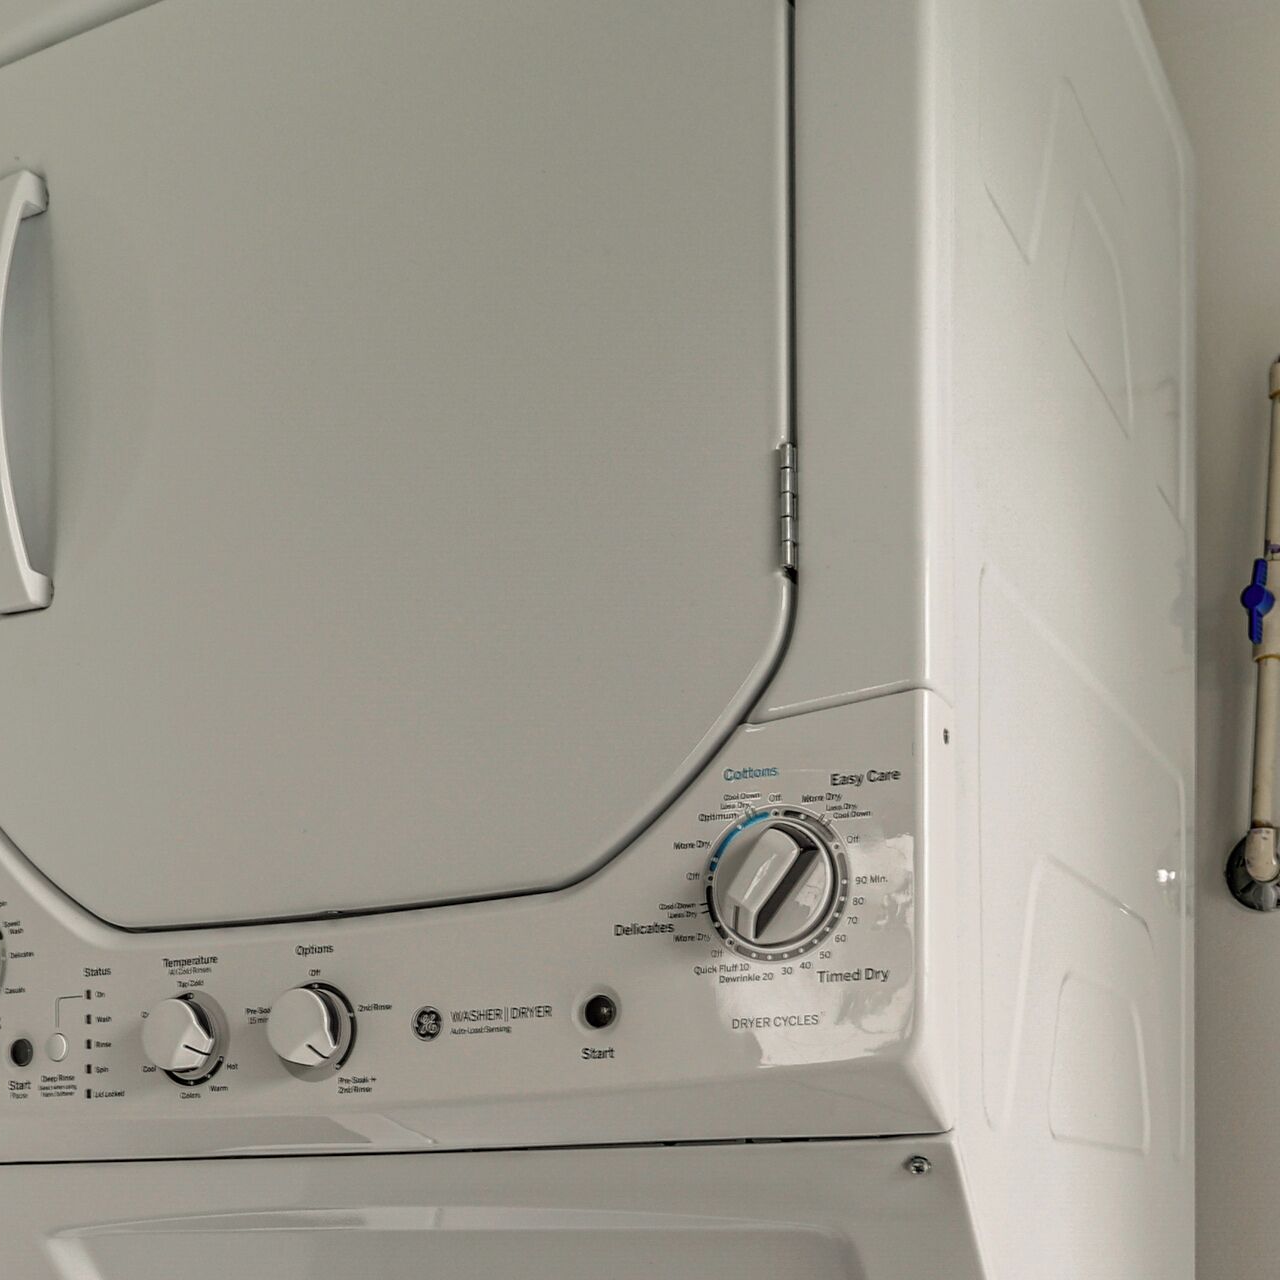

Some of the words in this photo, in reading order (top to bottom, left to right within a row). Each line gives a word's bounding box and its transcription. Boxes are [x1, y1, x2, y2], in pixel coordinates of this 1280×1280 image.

[723, 766, 779, 781] Cottons
[830, 773, 864, 787] Easy
[866, 769, 902, 783] Care
[769, 793, 782, 802] Off
[801, 795, 824, 803] More
[825, 793, 842, 801] Dry
[698, 812, 739, 822] Optimum
[851, 810, 871, 818] Down
[846, 835, 859, 844] Off
[673, 841, 695, 850] More
[696, 839, 711, 849] Dry
[686, 872, 700, 881] Off
[855, 875, 867, 884] 90
[869, 874, 888, 884] Min.
[676, 902, 697, 910] Down
[852, 897, 864, 906] 80
[686, 911, 697, 919] Dry
[847, 916, 858, 925] 70
[613, 921, 675, 936] Delicates
[673, 934, 696, 943] More
[697, 932, 711, 942] Dry
[834, 934, 846, 943] 60
[10, 951, 35, 959] Delicates
[294, 944, 335, 957] Options
[819, 950, 831, 959] 50
[162, 955, 219, 969] Temperature
[799, 961, 812, 970] 40
[84, 967, 112, 977] Status
[693, 966, 717, 976] Quick
[719, 963, 737, 972] Fluff
[739, 963, 750, 972] 10
[781, 966, 793, 975] 30
[718, 974, 760, 984] Dewrinkle
[762, 972, 774, 981] 20
[816, 968, 862, 983] Timed
[864, 967, 890, 983] Dry
[245, 1006, 272, 1015] Pre-Soa
[372, 1003, 392, 1011] Rinse
[449, 1007, 504, 1023] WASHER
[510, 1005, 553, 1020] DRYER
[731, 1017, 771, 1030] DRYER
[773, 1014, 819, 1027] CYCLES
[581, 1046, 615, 1060] Start
[95, 1066, 109, 1074] Spin
[142, 1065, 157, 1073] Cool
[41, 1075, 58, 1083] Deep
[8, 1080, 32, 1091] Start
